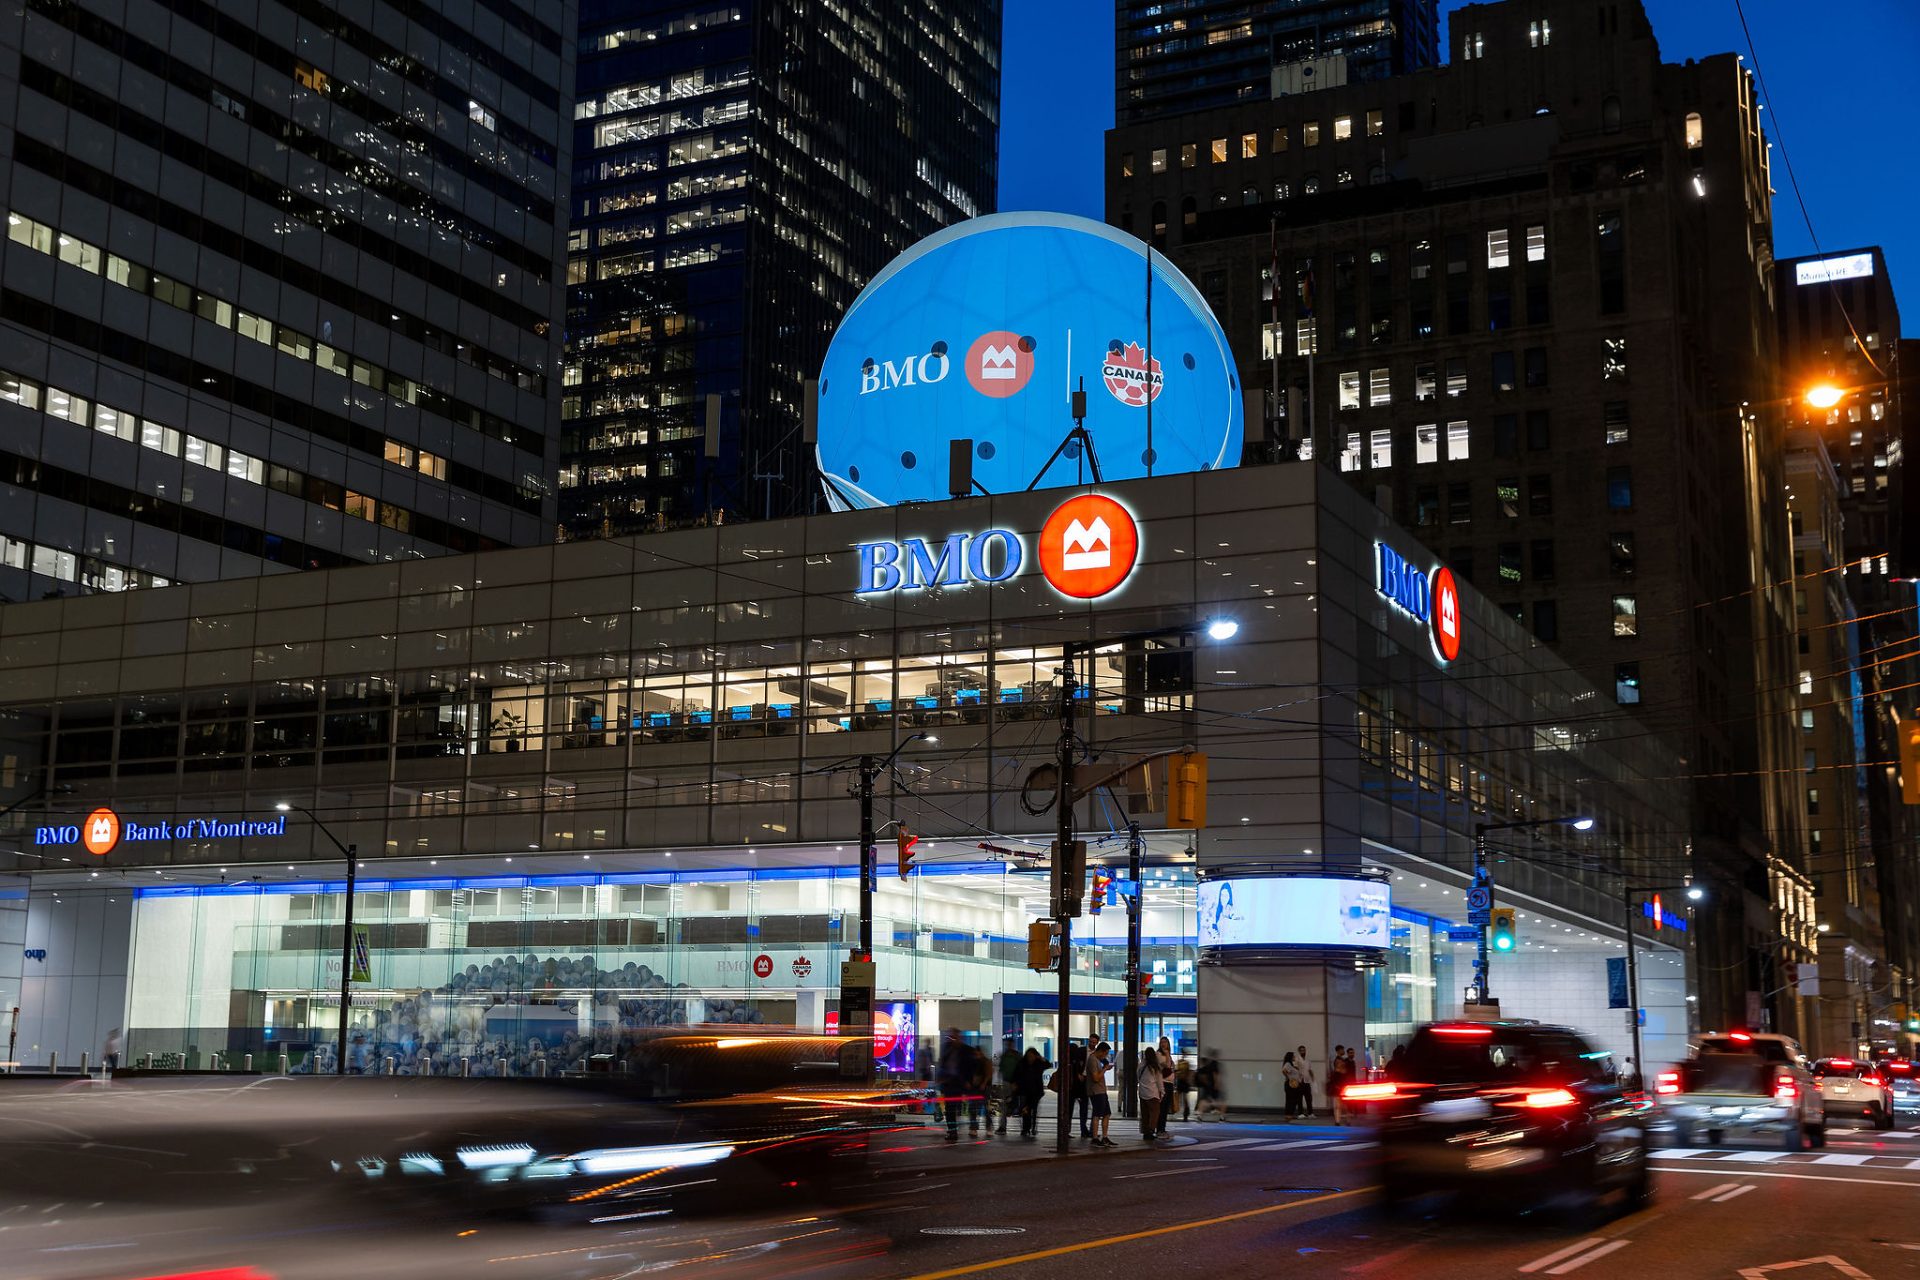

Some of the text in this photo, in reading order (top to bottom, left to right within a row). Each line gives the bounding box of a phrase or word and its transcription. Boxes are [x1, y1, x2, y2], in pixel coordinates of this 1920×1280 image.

[860, 351, 949, 395] BMO
[1103, 366, 1163, 385] CANADA
[855, 529, 1023, 594] BMO
[1374, 540, 1431, 622] BMO
[35, 815, 286, 845] BMO Bank of Montreal
[717, 960, 749, 972] BMO
